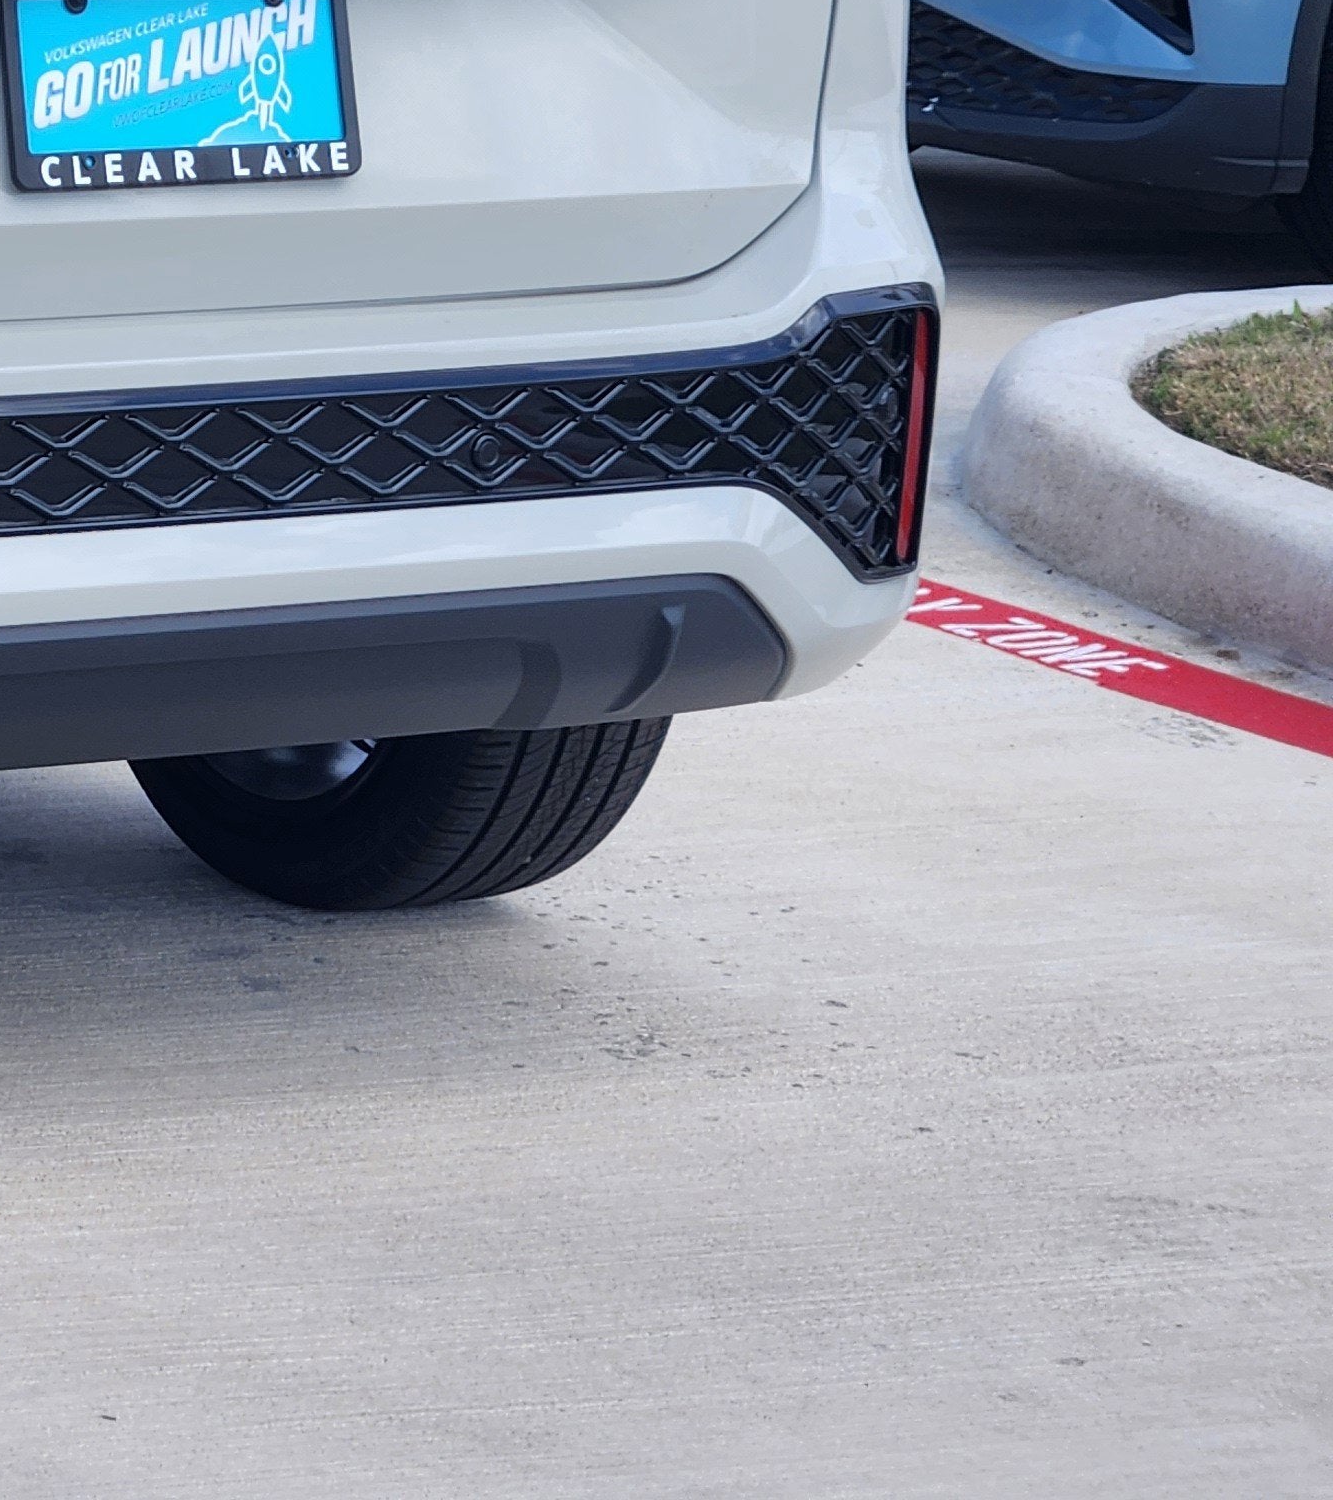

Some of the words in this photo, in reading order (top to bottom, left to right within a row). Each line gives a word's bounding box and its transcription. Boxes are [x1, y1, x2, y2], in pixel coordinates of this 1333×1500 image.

[44, 26, 133, 65] VOLKSWAGEN
[135, 12, 174, 37] CLEAR
[178, 2, 210, 23] LAKE
[34, 61, 95, 129] GO
[97, 53, 142, 106] FOR
[40, 149, 197, 187] CLEAR
[232, 142, 350, 178] LAKE
[938, 616, 1169, 678] ZONE
